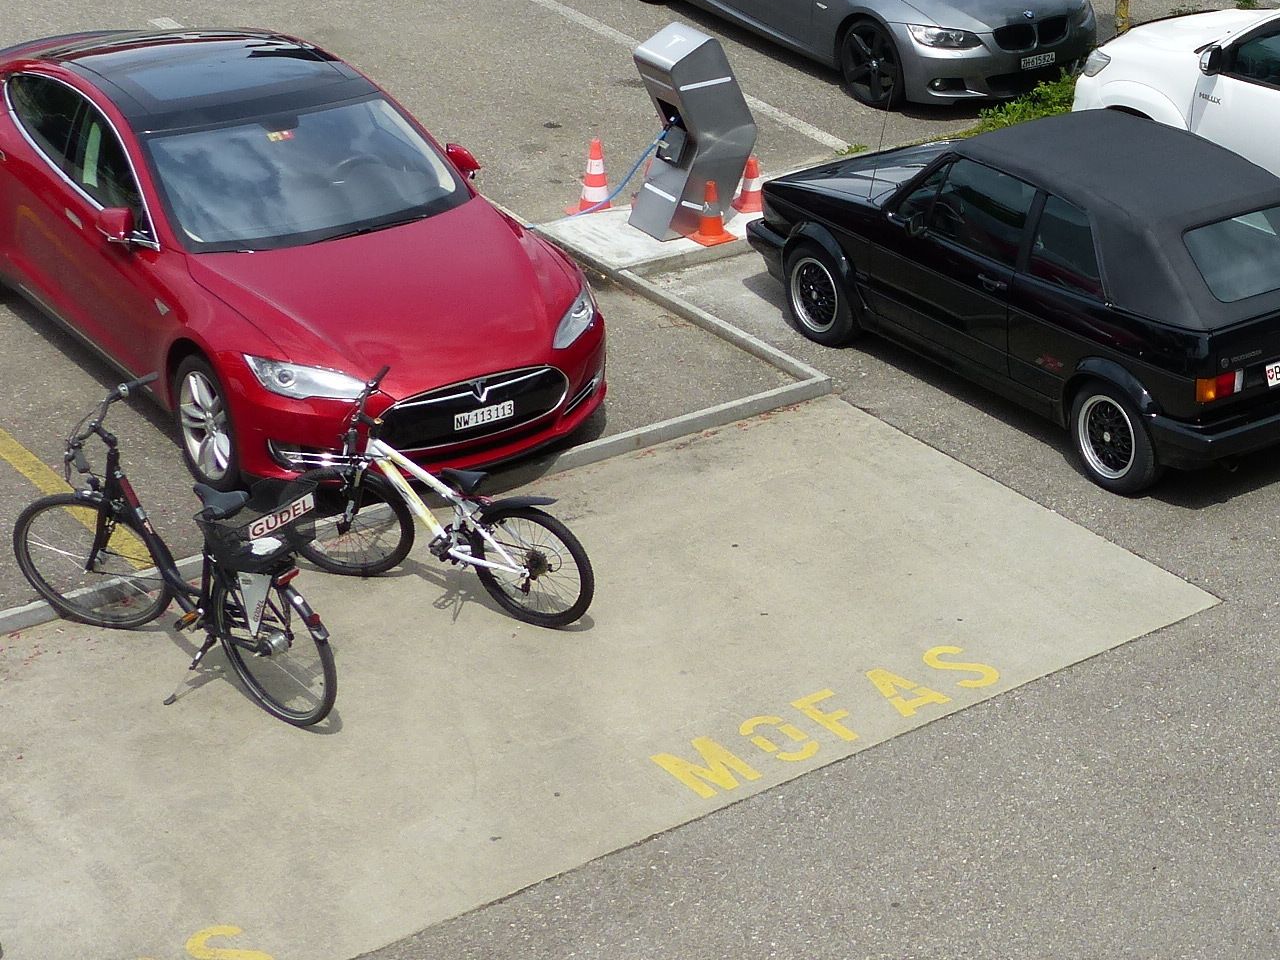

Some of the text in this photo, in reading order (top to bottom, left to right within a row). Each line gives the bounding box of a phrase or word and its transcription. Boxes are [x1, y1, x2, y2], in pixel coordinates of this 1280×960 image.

[1199, 91, 1221, 105] HILUX
[456, 414, 471, 429] NW
[251, 499, 312, 537] GÜDEL
